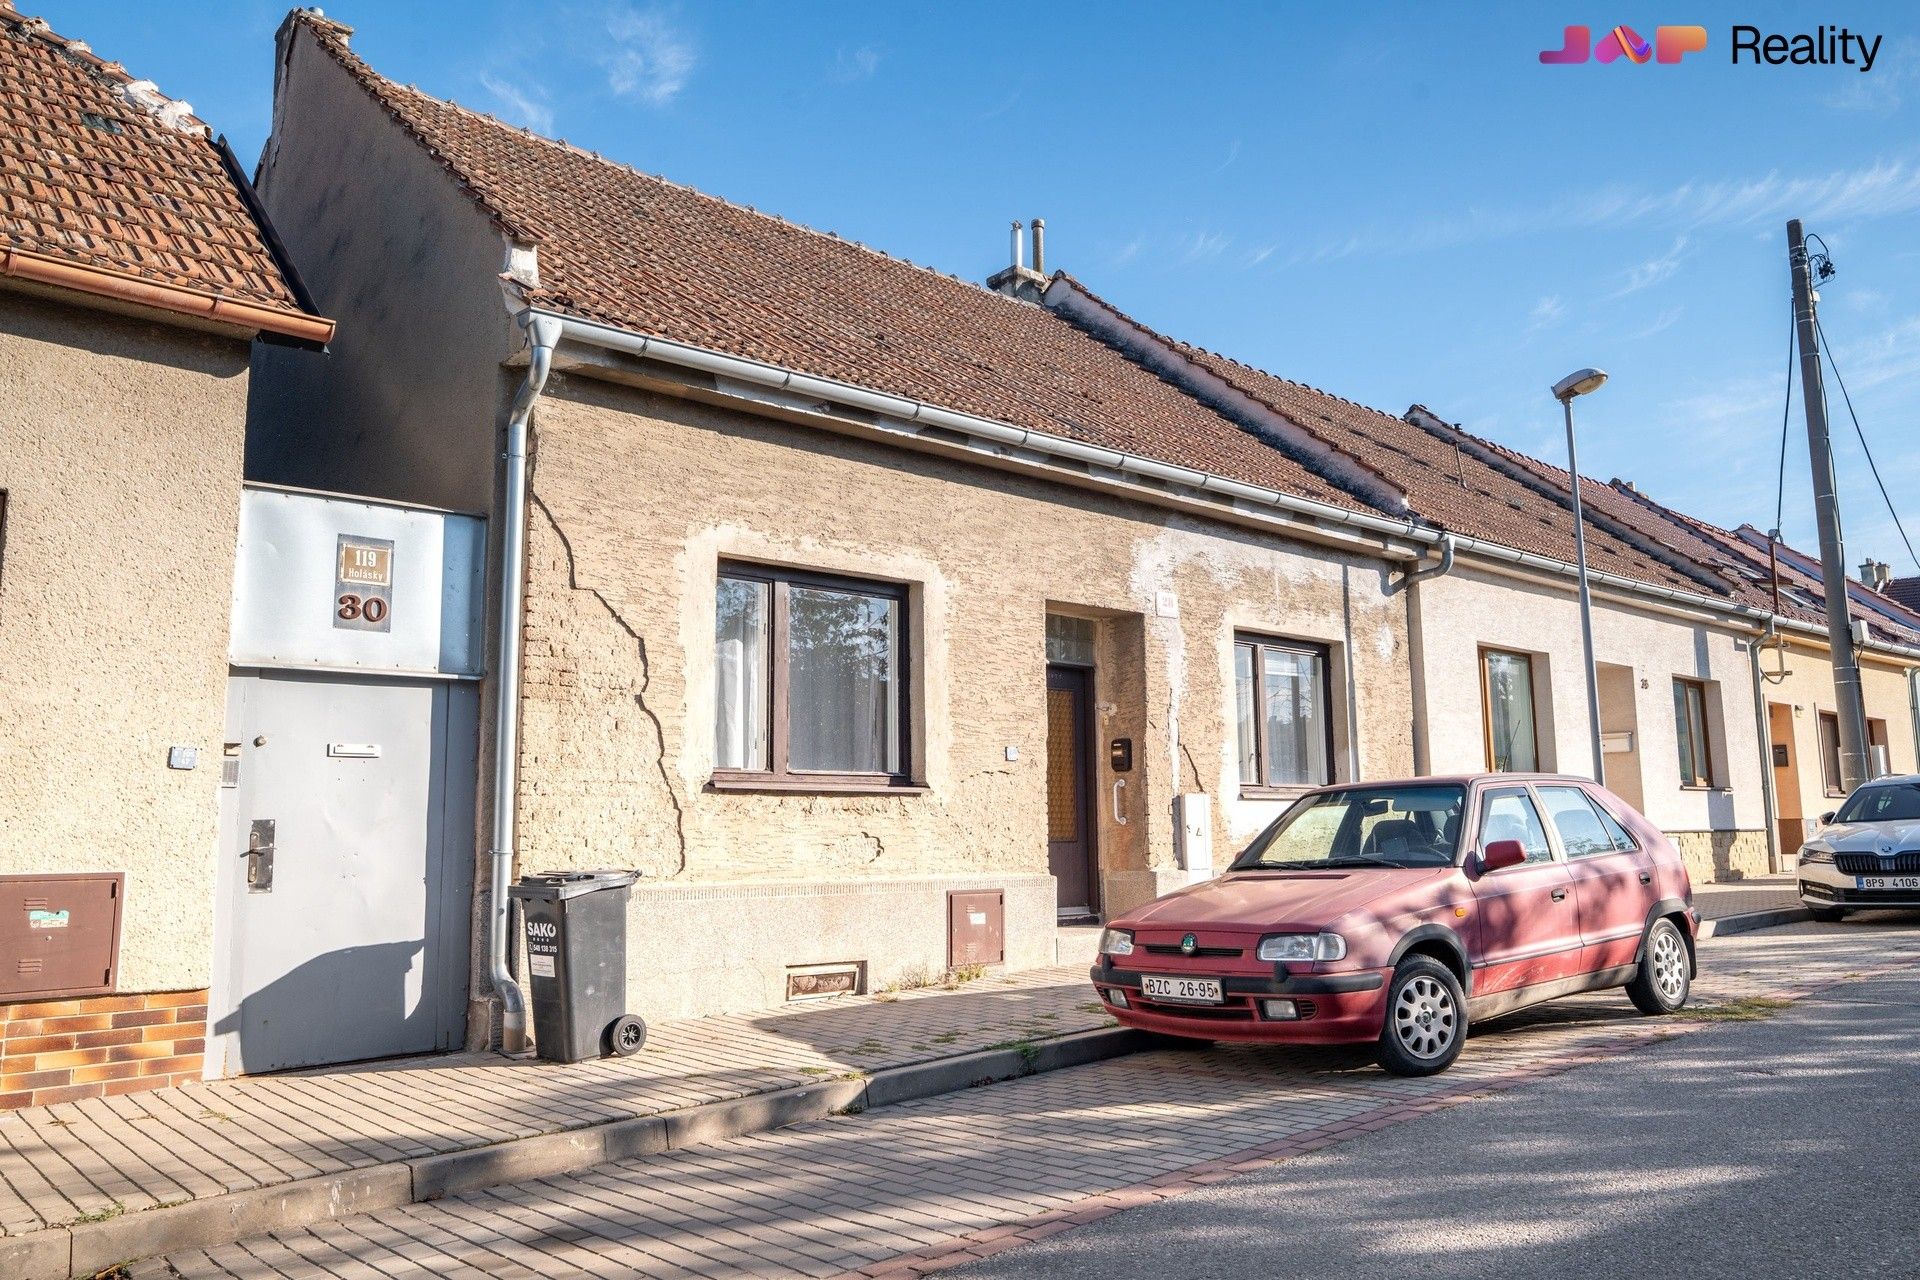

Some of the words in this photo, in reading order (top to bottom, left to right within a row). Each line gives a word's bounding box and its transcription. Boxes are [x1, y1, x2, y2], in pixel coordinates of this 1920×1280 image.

[355, 550, 377, 567] 119
[348, 567, 383, 582] Holásky
[337, 594, 388, 622] 30
[1865, 878, 1885, 888] 8P9
[1892, 878, 1919, 888] 4106
[527, 921, 557, 938] SAKO
[1148, 979, 1171, 995] BZC
[1179, 981, 1215, 998] 26-95
